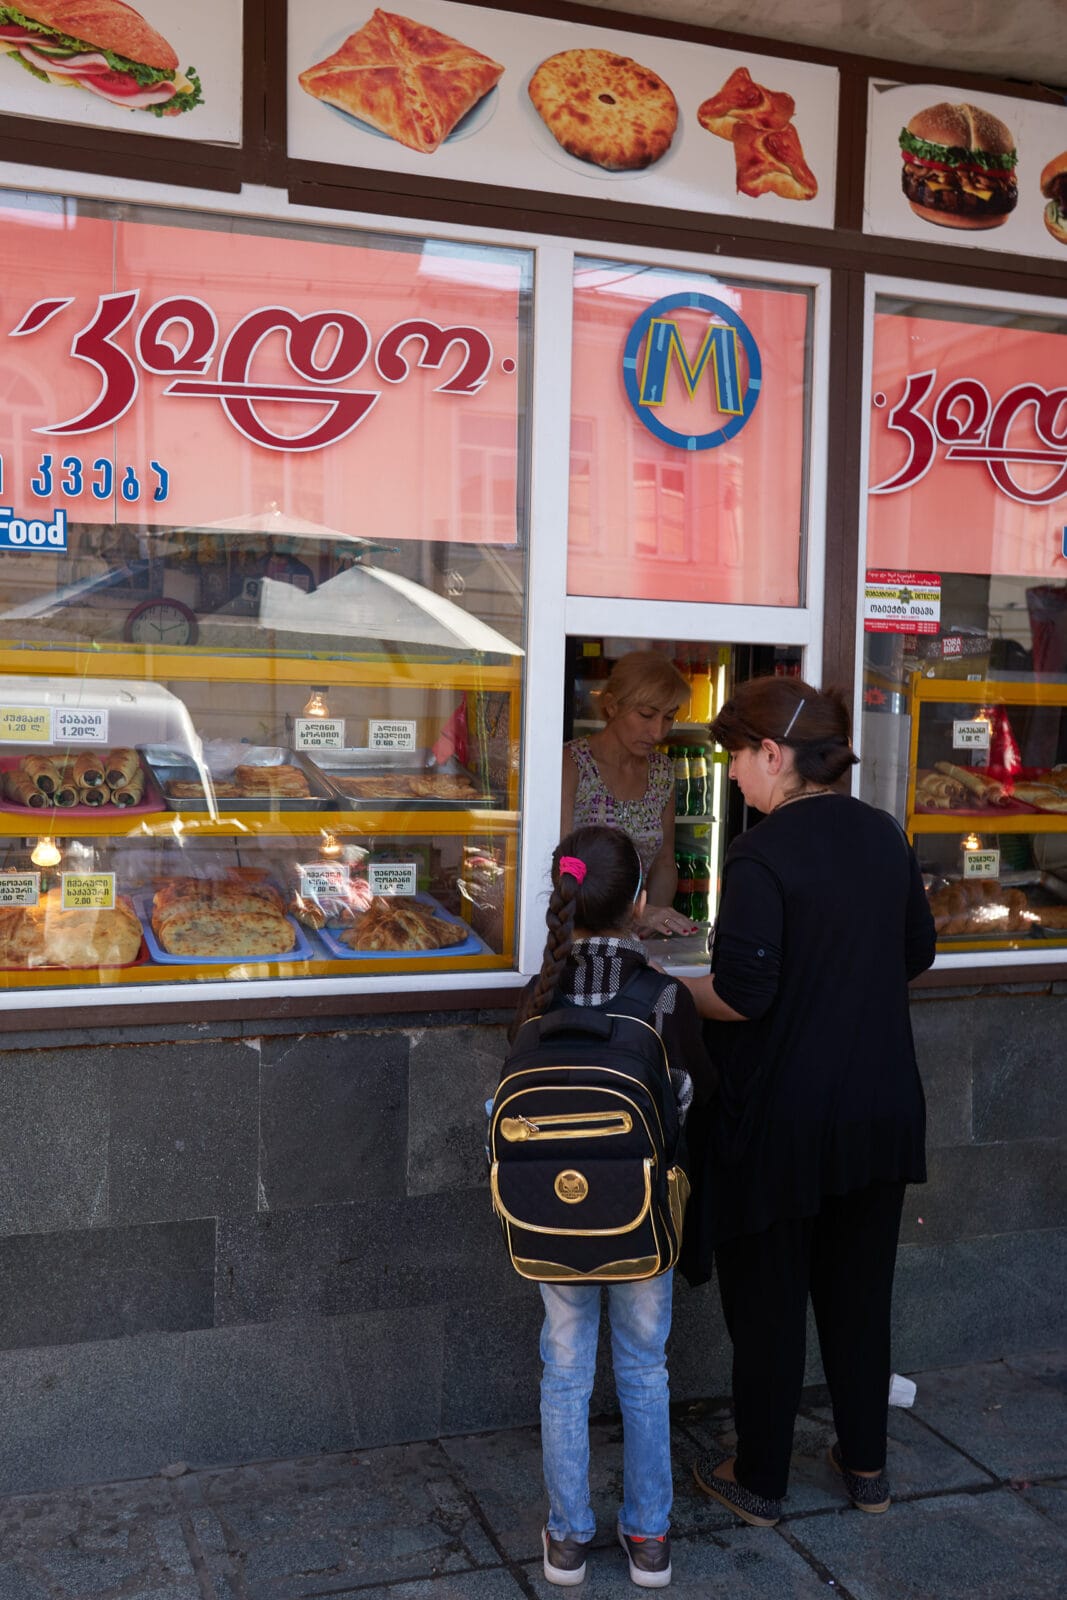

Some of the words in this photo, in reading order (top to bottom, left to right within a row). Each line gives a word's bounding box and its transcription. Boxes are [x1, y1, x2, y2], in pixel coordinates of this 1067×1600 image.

[639, 318, 744, 416] M
[31, 453, 169, 502] კვება
[870, 604, 907, 614] ობიექტს
[910, 606, 934, 616] იცავს
[59, 714, 102, 725] ქაბაბი
